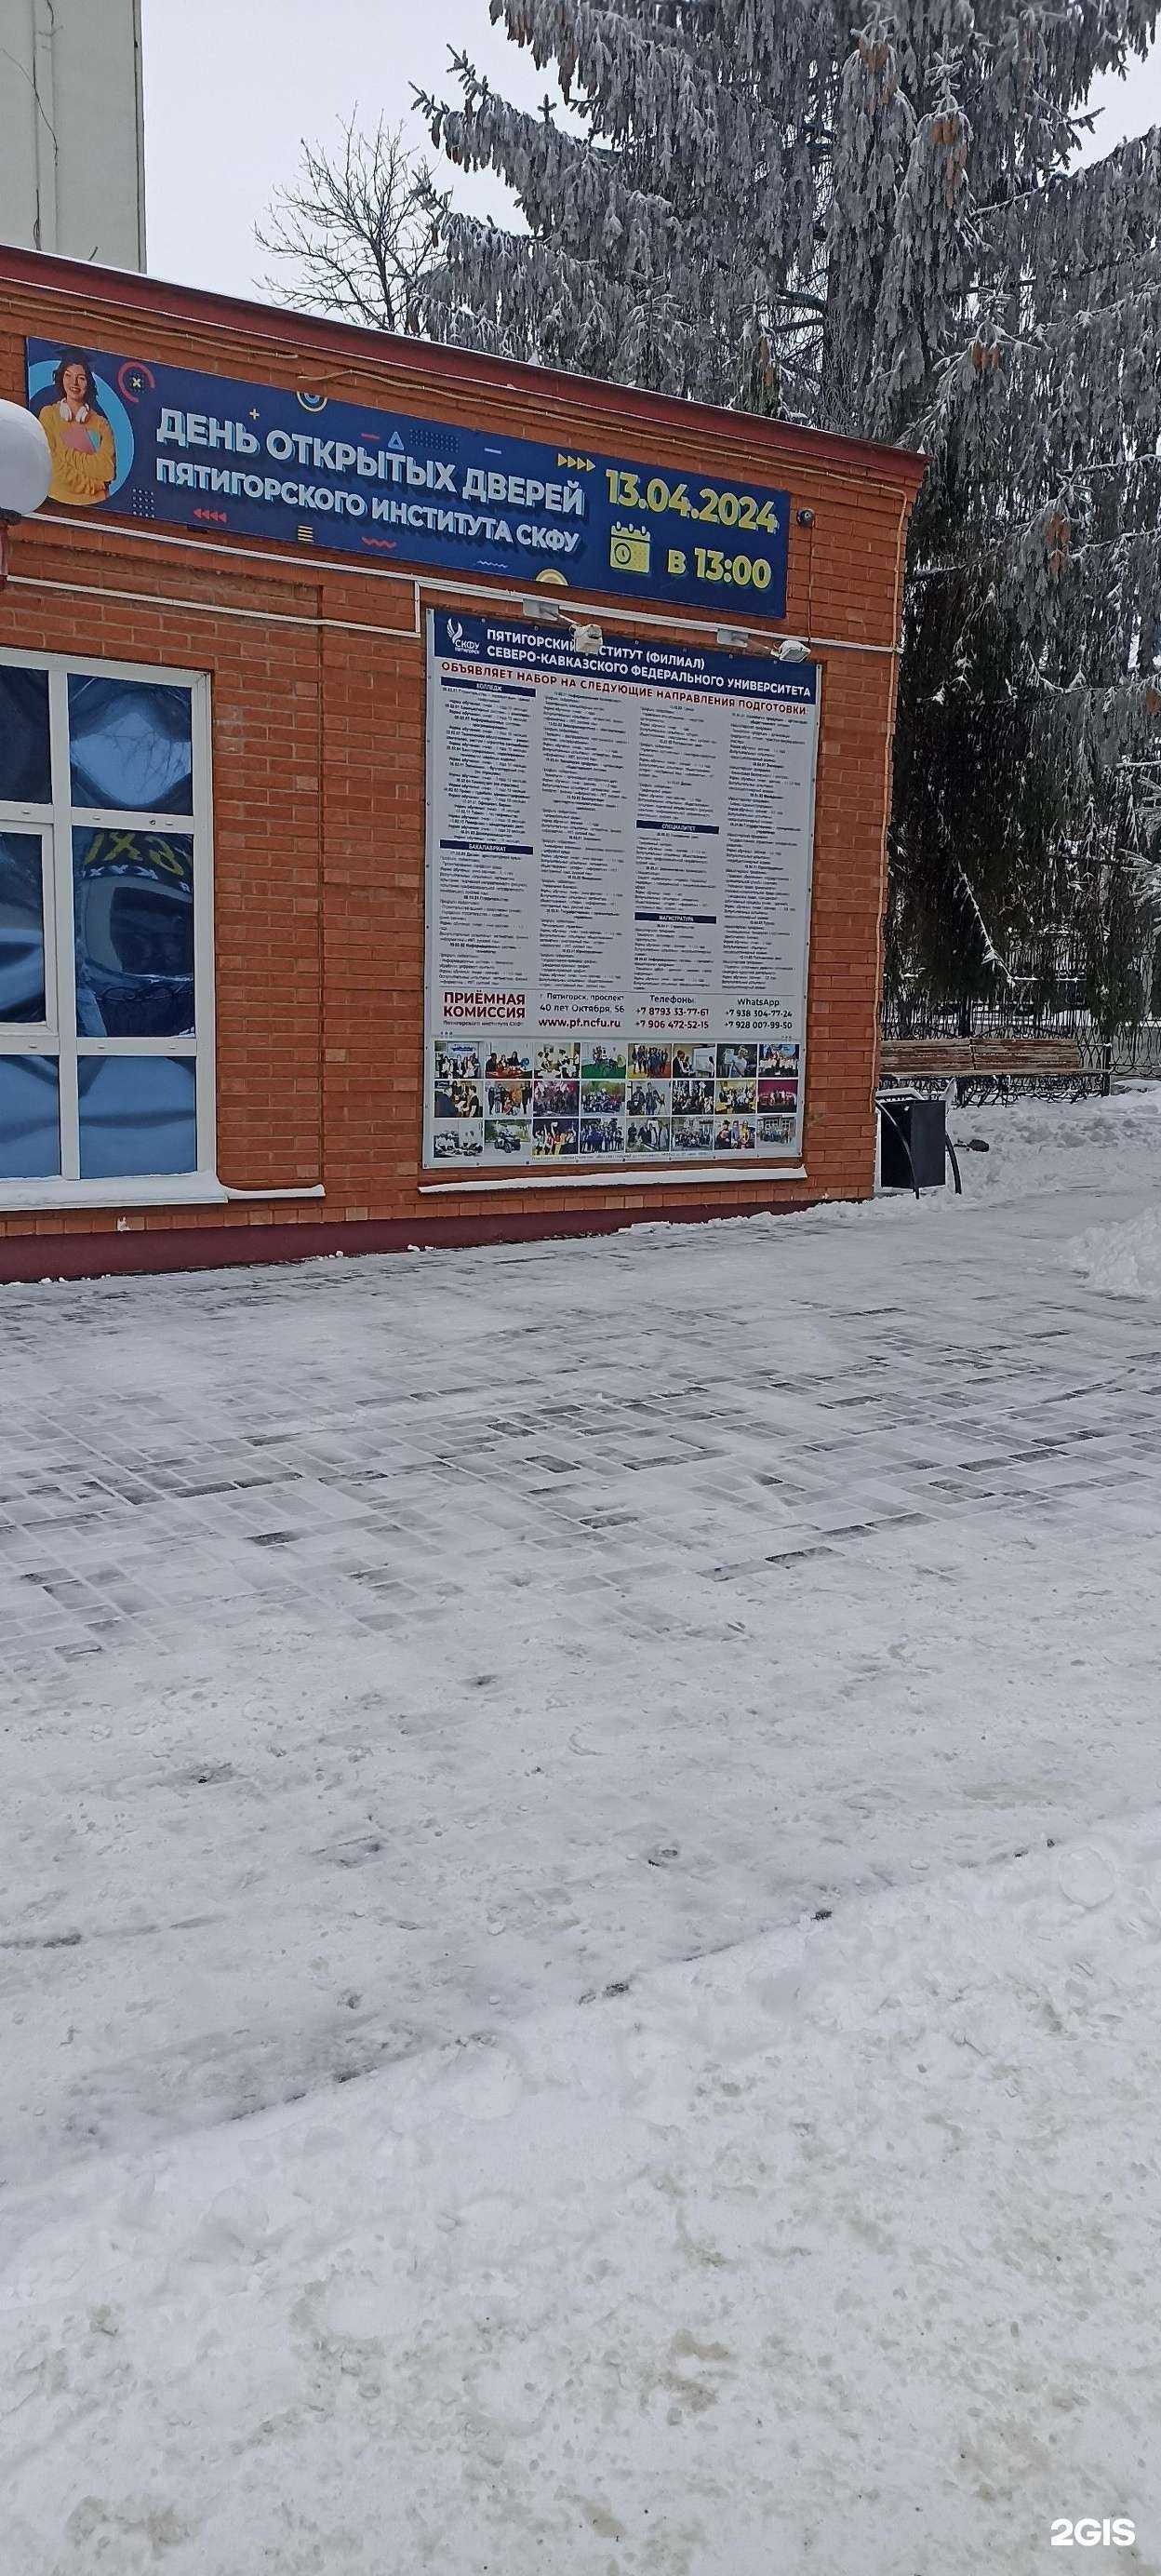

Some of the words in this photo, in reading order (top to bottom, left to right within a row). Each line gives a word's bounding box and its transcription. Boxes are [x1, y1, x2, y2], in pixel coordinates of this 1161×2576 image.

[156, 407, 260, 455] ДЕНЬ
[266, 429, 457, 493] ОТКРЫТЫХ
[462, 467, 584, 516] ДВЕРЕЙ
[156, 457, 367, 517] ПЯТИГОРСКОГО
[372, 497, 513, 543] ИНСТИТУТА
[516, 524, 579, 553] СКФУ
[606, 468, 779, 534] 13.04.2024
[694, 546, 772, 589] 13:00
[455, 639, 480, 650] СКФУ
[646, 649, 705, 670] (ФИЛИАЛ)
[487, 644, 628, 675] СЕВЕРО-КАВКАЗСКОГО
[631, 664, 724, 687] ФЕДЕРАЛЬНОГО
[727, 678, 810, 697] УНИВЕРСИТЕТА
[442, 662, 513, 679] ОБЪЯВЛЯЕТ
[516, 672, 556, 685] НАБОР
[561, 678, 576, 688] НА
[580, 680, 652, 698] СЛЕДУЮЩИЕ
[657, 690, 735, 707] НАПРАВЛЕНИЯ
[469, 843, 506, 852] БАКАЛАВРИАТ
[444, 990, 526, 1005] ПРИЁМНАЯ
[738, 998, 780, 1007] WhatsApp
[444, 1006, 526, 1019] КОМИССИЯ
[636, 1007, 646, 1015] +7
[648, 1007, 671, 1015] 8793
[539, 1017, 621, 1029] www.pf.ncfu.ru
[635, 1020, 646, 1028] +7
[647, 1020, 665, 1028] 906
[668, 1020, 709, 1029] 472-52-15
[736, 1020, 751, 1028] 928
